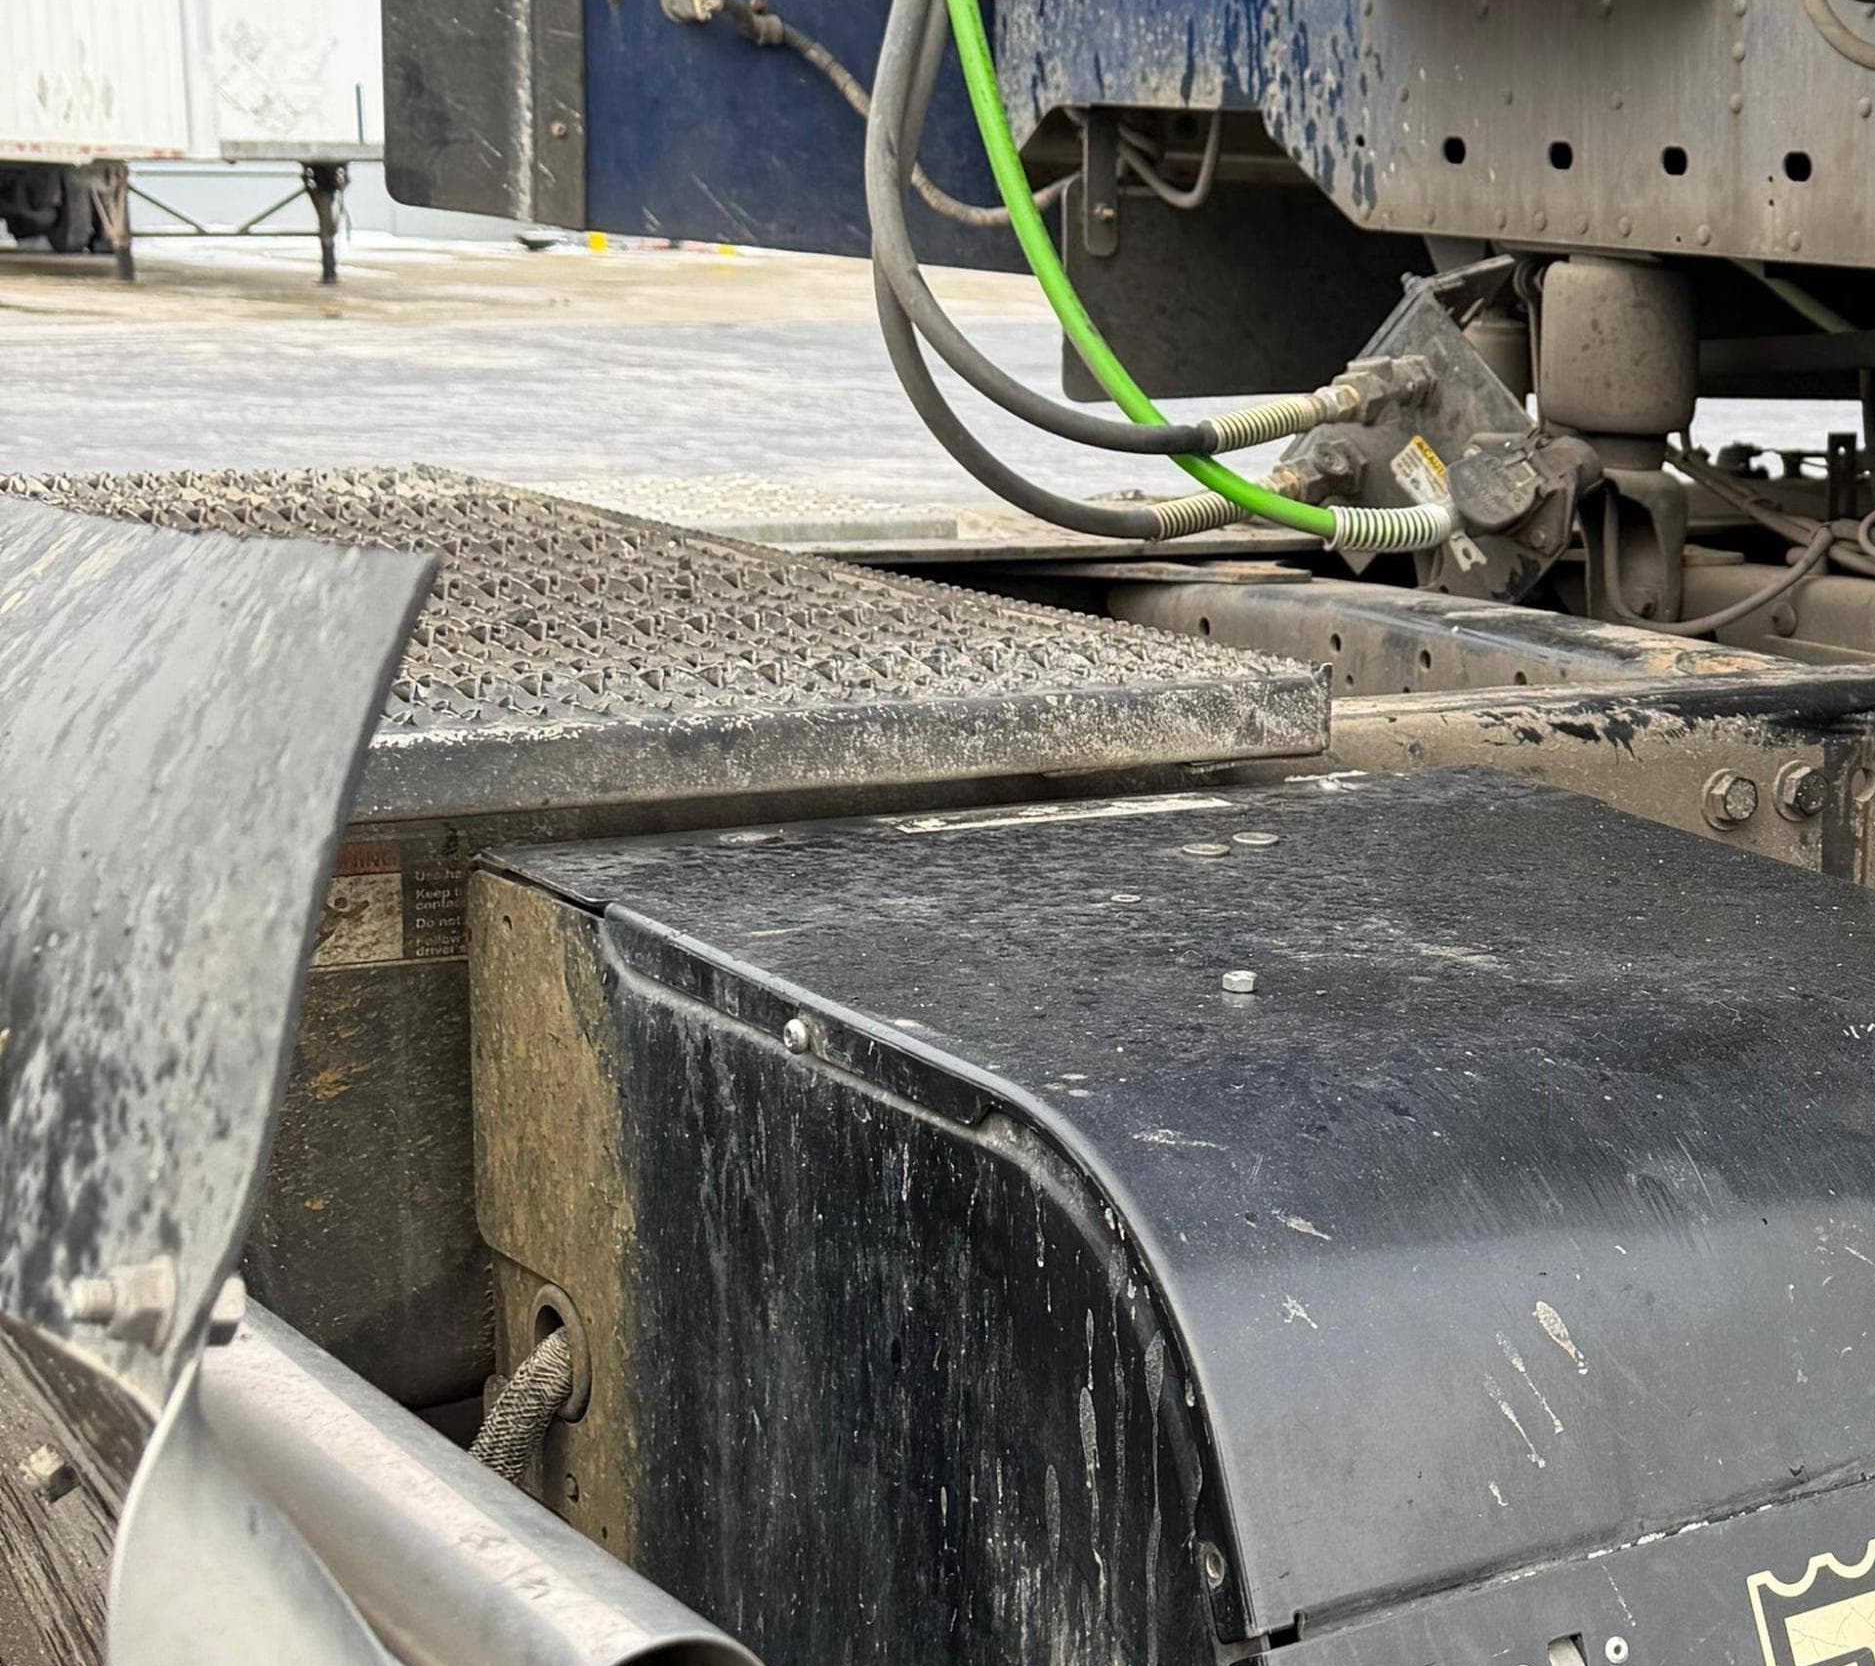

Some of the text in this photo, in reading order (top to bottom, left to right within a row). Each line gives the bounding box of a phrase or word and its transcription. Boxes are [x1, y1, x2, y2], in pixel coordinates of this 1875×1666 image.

[416, 887, 450, 904] Keep
[416, 915, 461, 929] Do not
